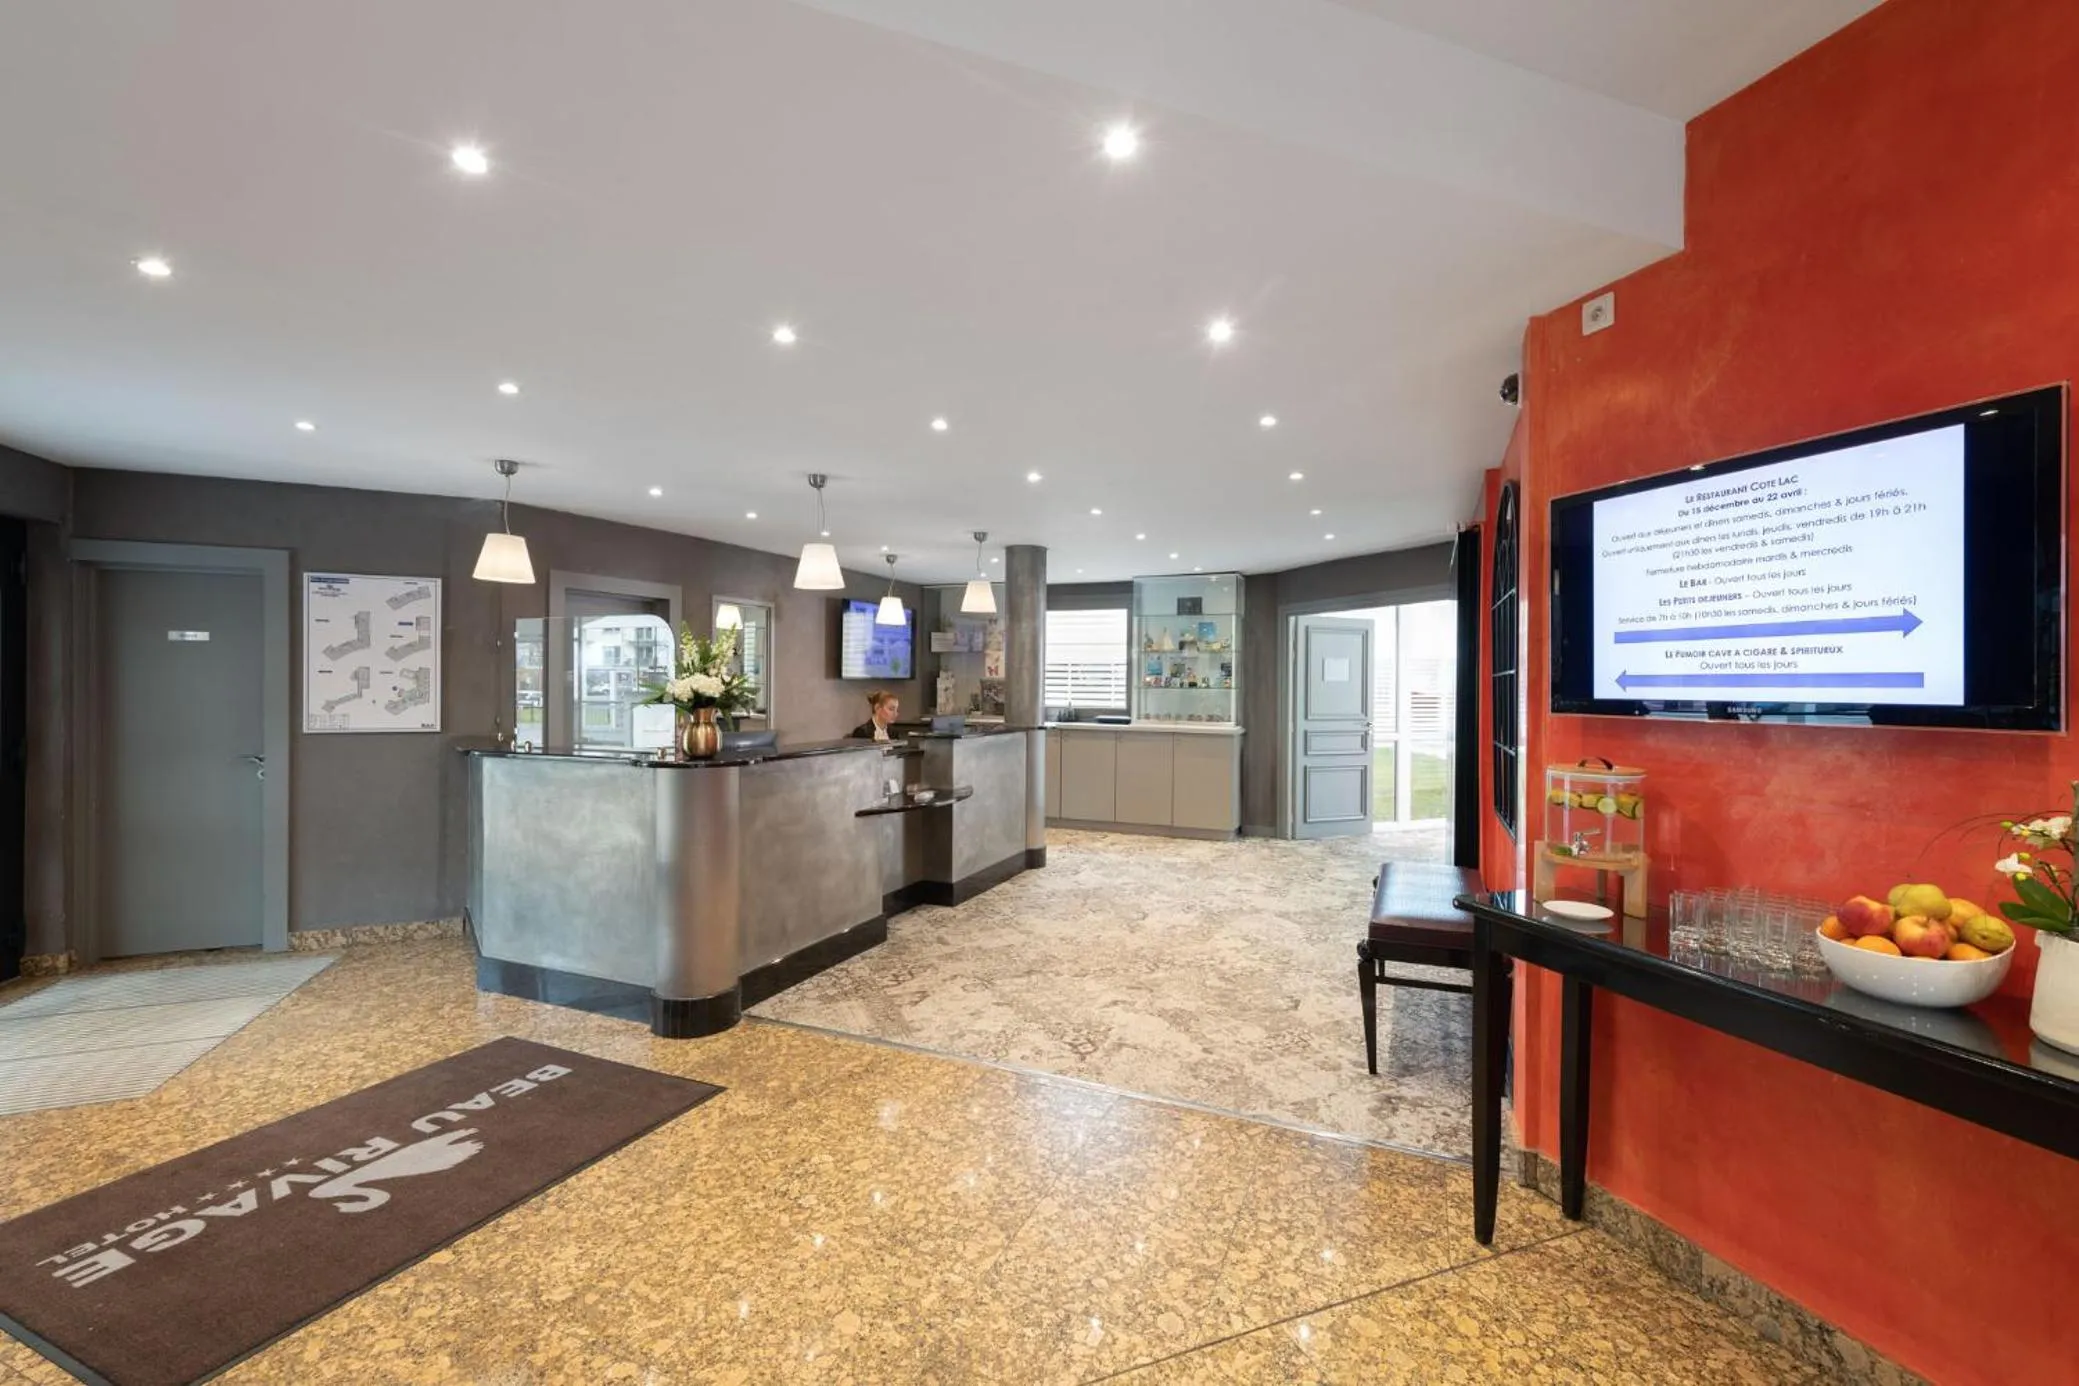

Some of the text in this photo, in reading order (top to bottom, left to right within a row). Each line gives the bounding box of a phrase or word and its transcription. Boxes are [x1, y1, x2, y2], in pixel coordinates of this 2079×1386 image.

[1696, 486, 1747, 501] RESTAURANT
[1779, 475, 1798, 486] LAC
[1703, 499, 1749, 512] décembre
[1767, 493, 1778, 501] 22
[1781, 489, 1802, 499] avril
[1612, 532, 1636, 543] Ouvert
[1775, 500, 1831, 516] dimanches
[1835, 498, 1843, 506] &
[1846, 494, 1870, 505] jours
[1602, 547, 1626, 558] Ouvert
[1628, 542, 1673, 554] uniquement
[1796, 513, 1846, 528] vendredis
[1850, 512, 1865, 521] de
[1869, 509, 1889, 518] 19h
[1892, 506, 1901, 515] à
[1905, 504, 1926, 513] 21h
[1701, 546, 1712, 555] les
[1715, 541, 1758, 552] vendredis
[1771, 532, 1814, 546] samedis)
[1646, 544, 1852, 576] Fermeture hebdomadaire mardis & mercredis
[1690, 579, 1707, 587] BAR
[1715, 575, 1744, 585] Ouvert
[1747, 572, 1766, 580] tous
[1768, 571, 1781, 579] les
[1783, 568, 1806, 580] jours
[1752, 588, 1784, 599] Ouvert
[1789, 587, 1808, 595] tous
[1811, 585, 1824, 593] les
[1827, 583, 1852, 594] jours
[1724, 609, 1736, 617] les
[1781, 601, 1838, 613] dimanches
[1853, 598, 1878, 609] jours
[1676, 650, 1706, 658] FUMOIR
[1743, 647, 1777, 657] CIGARE
[1780, 647, 1787, 655] &
[1791, 645, 1843, 655] SPIRITUEUX
[1700, 660, 1798, 670] Ouvert tous les jours
[52, 1064, 573, 1289] BEAU RIVAGE
[35, 1204, 188, 1266] HOTEL
